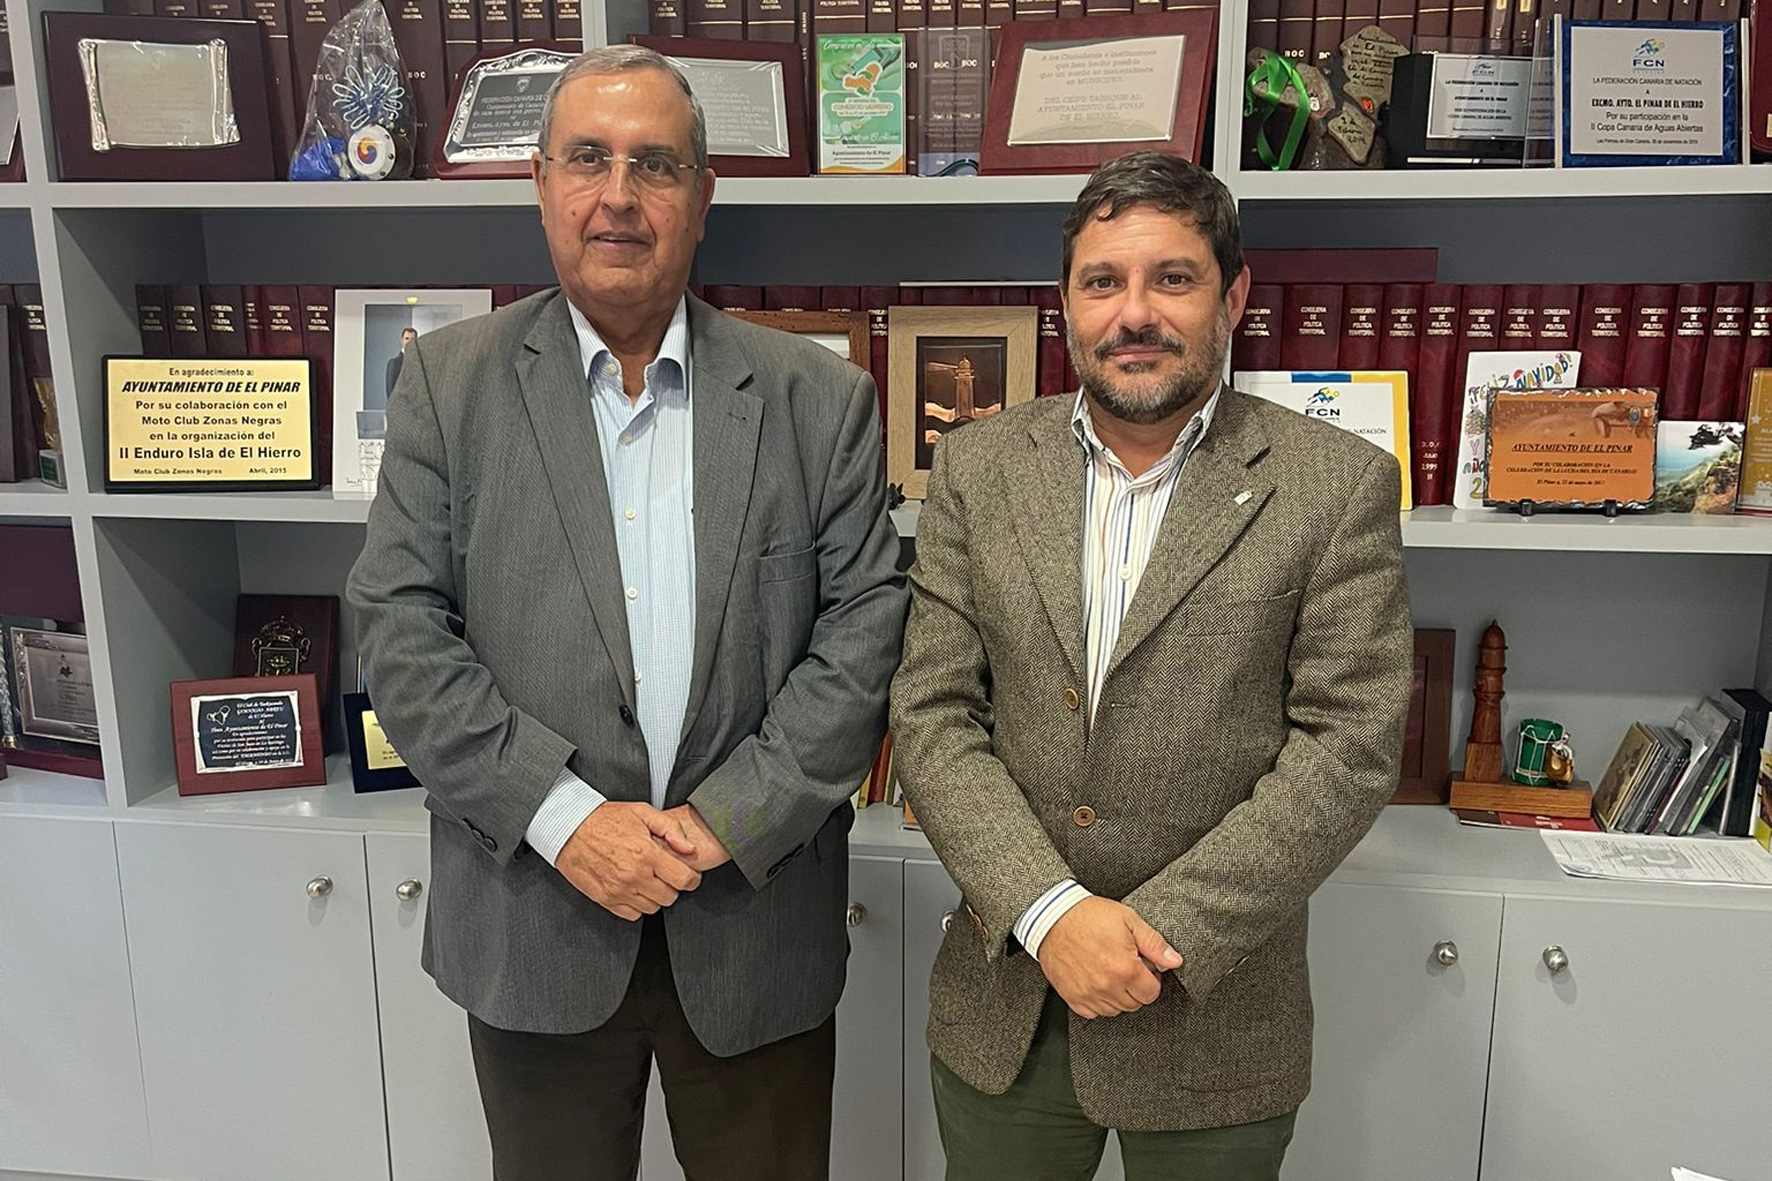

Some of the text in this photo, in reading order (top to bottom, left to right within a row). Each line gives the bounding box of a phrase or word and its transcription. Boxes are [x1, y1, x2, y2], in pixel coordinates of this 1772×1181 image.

[1644, 100, 1662, 108] PINAR
[1665, 100, 1672, 108] DE
[1674, 100, 1679, 108] EL
[1681, 100, 1703, 108] HIERRO
[1630, 112, 1670, 120] participación
[1597, 123, 1614, 131] Copa
[1617, 123, 1642, 131] Canaria
[1654, 124, 1674, 133] Aguas
[181, 369, 244, 377] agradecimiento
[122, 382, 300, 392] AYUNTAMIENTO DE EL PINAR
[136, 401, 154, 409] Por
[176, 401, 249, 409] colaboración
[277, 401, 286, 409] el
[242, 417, 282, 426] Negras
[168, 431, 177, 440] la
[181, 431, 254, 442] organización
[258, 431, 274, 439] del
[1470, 439, 1480, 455] Y
[1512, 444, 1578, 452] AYUNTAMIENTO
[1606, 445, 1633, 453] PINAR
[120, 447, 300, 458] II Enduro Isla de El Hierro
